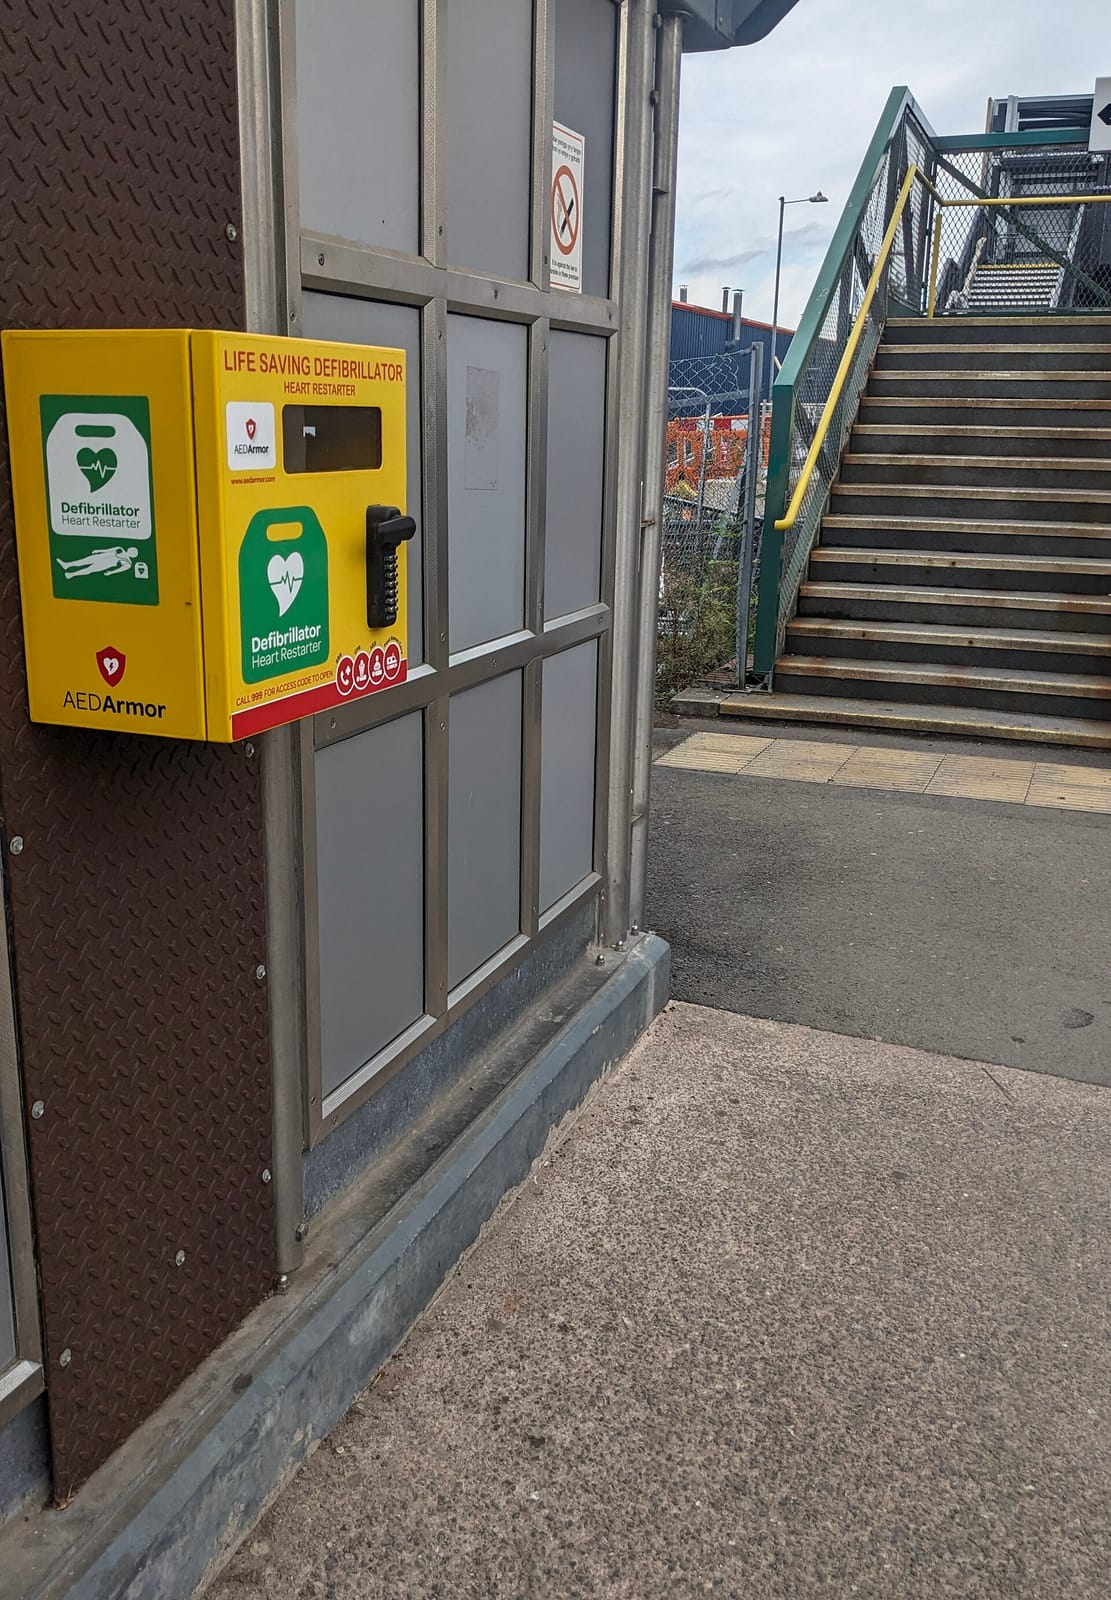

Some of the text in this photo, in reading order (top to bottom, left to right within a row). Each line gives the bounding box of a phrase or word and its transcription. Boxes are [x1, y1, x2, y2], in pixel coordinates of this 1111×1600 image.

[224, 350, 403, 382] LIFE SAVING DEFIBRILLATOR
[283, 381, 356, 397] HEART RESTARTER
[61, 501, 140, 518] Defibrillator
[61, 515, 141, 529] Heart Restarter
[251, 624, 321, 653] Defibrillator
[252, 652, 280, 670] Heart
[280, 641, 322, 662] Restarter
[235, 670, 334, 707] CALL 999 FOR ACCESS CODE TO OPEN
